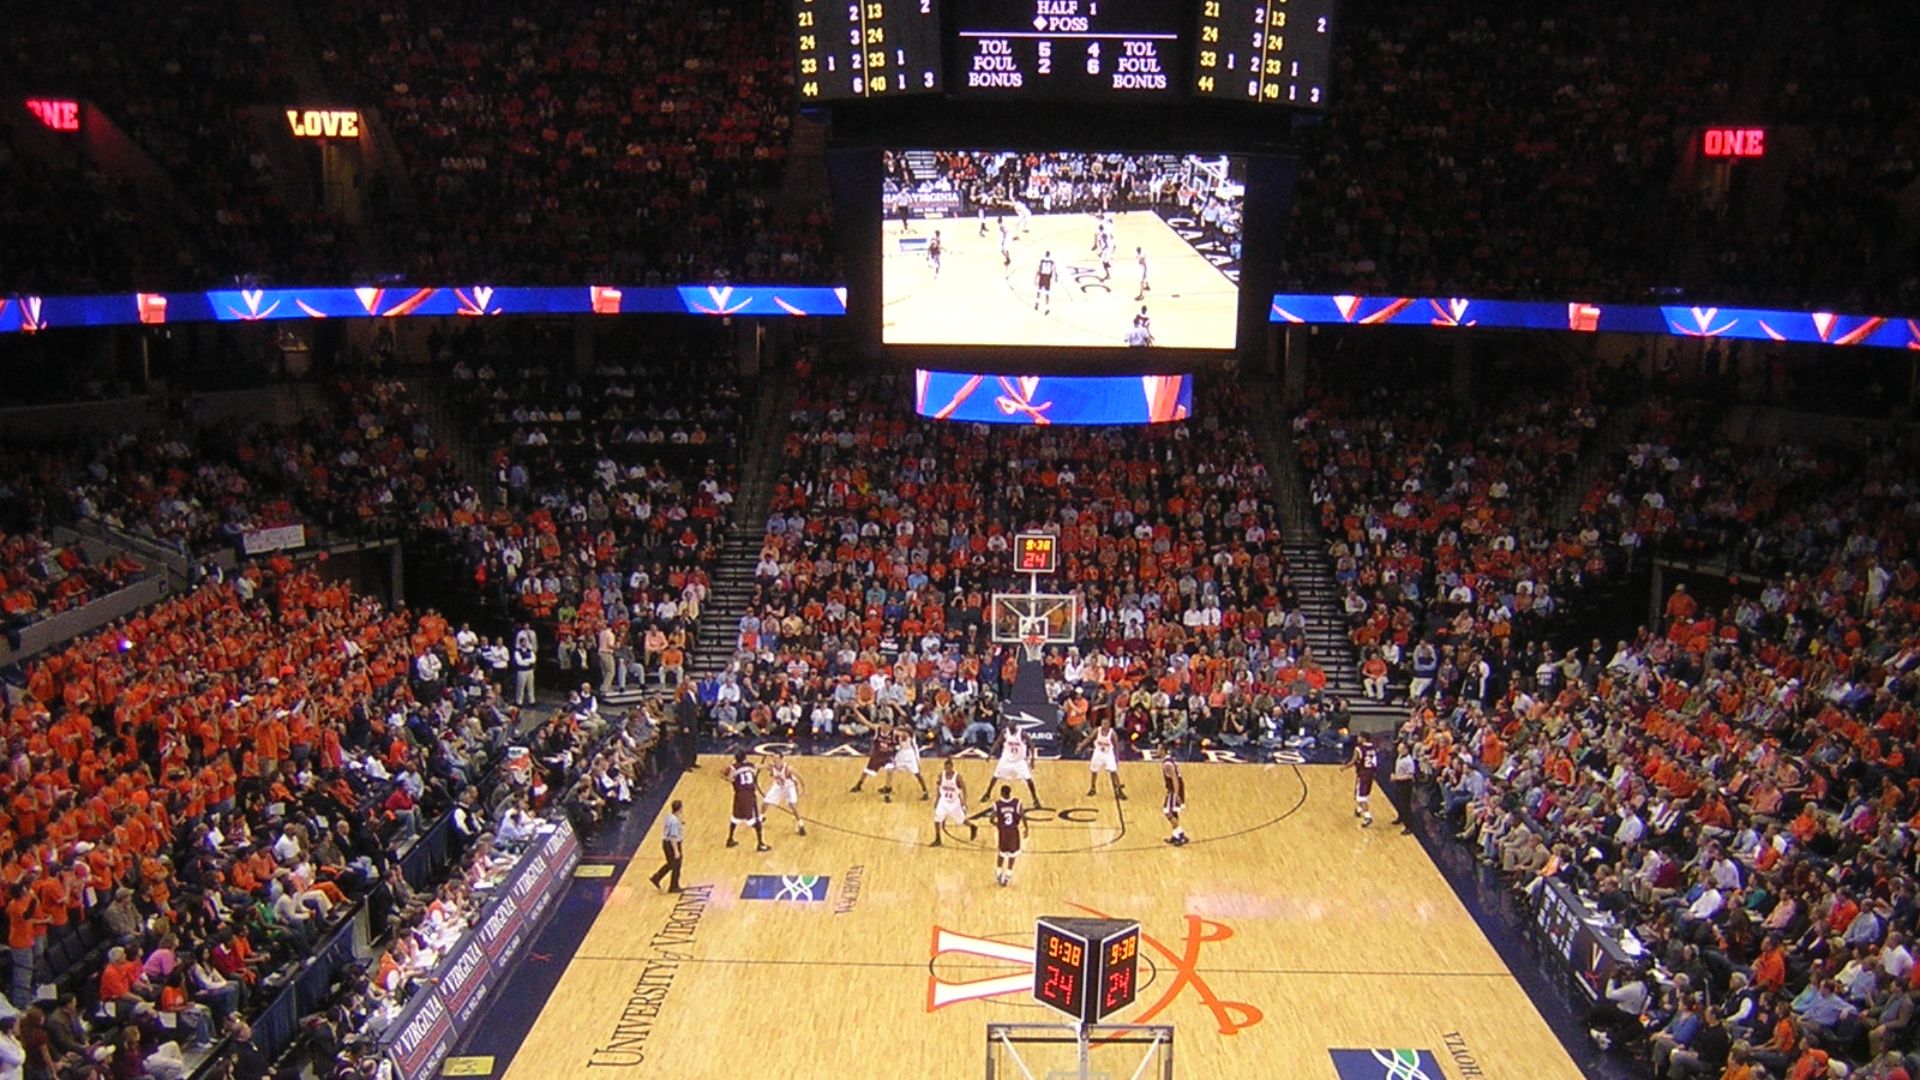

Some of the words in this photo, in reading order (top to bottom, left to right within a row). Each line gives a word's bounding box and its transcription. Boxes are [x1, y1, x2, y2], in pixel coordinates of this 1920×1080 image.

[798, 12, 814, 27] 21
[850, 6, 858, 21] 2
[868, 4, 882, 19] 13
[920, 0, 930, 14] 2
[1037, 0, 1078, 15] HALF
[1090, 2, 1097, 16] 1
[1205, 2, 1220, 17] 21
[1255, 8, 1264, 24] 2
[1049, 16, 1088, 31] POSS
[1272, 11, 1286, 26] 13
[1317, 18, 1326, 33] 2
[800, 35, 816, 50] 24
[850, 30, 860, 45] 3
[868, 28, 884, 44] 24
[1202, 26, 1218, 42] 24
[1253, 32, 1262, 48] 3
[1268, 35, 1284, 50] 24
[869, 52, 884, 68] 33
[896, 50, 904, 66] 1
[978, 40, 1012, 55] TOL
[1038, 42, 1052, 57] 5
[1087, 42, 1100, 58] 4
[1123, 42, 1157, 56] TOL
[802, 58, 817, 74] 33
[828, 56, 836, 71] 1
[852, 54, 862, 69] 2
[974, 56, 1017, 70] FOUL
[1038, 58, 1050, 74] 2
[1087, 58, 1100, 74] 6
[1118, 58, 1160, 72] FOUL
[1200, 52, 1216, 68] 33
[1227, 54, 1234, 70] 1
[1251, 56, 1260, 72] 2
[1266, 60, 1281, 74] 33
[1292, 62, 1298, 77] 1
[803, 82, 818, 97] 44
[853, 78, 862, 92] 6
[870, 76, 886, 92] 40
[898, 74, 906, 90] 1
[924, 72, 934, 88] 3
[968, 73, 1022, 88] BONUS
[1113, 74, 1166, 89] BONUS
[1198, 76, 1214, 92] 44
[1248, 80, 1258, 96] 6
[1264, 84, 1279, 98] 40
[1290, 85, 1296, 100] 1
[1310, 88, 1320, 103] 3
[287, 110, 358, 137] LOVE
[1705, 130, 1764, 155] ONE
[1024, 552, 1046, 568] 24
[754, 742, 1307, 764] CAALERS
[740, 772, 754, 786] 13
[1004, 812, 1014, 826] 3
[1048, 936, 1082, 967] 9:38
[1110, 935, 1136, 966] 9:38
[444, 941, 483, 993] VIRGINIA
[587, 958, 679, 1068] UNIVERSITY
[650, 884, 714, 948] VIRGINIA
[1044, 965, 1074, 1006] 24
[1106, 967, 1130, 1008] 24
[400, 994, 444, 1053] VIRGINIA
[1443, 1030, 1485, 1080] HOVIA
